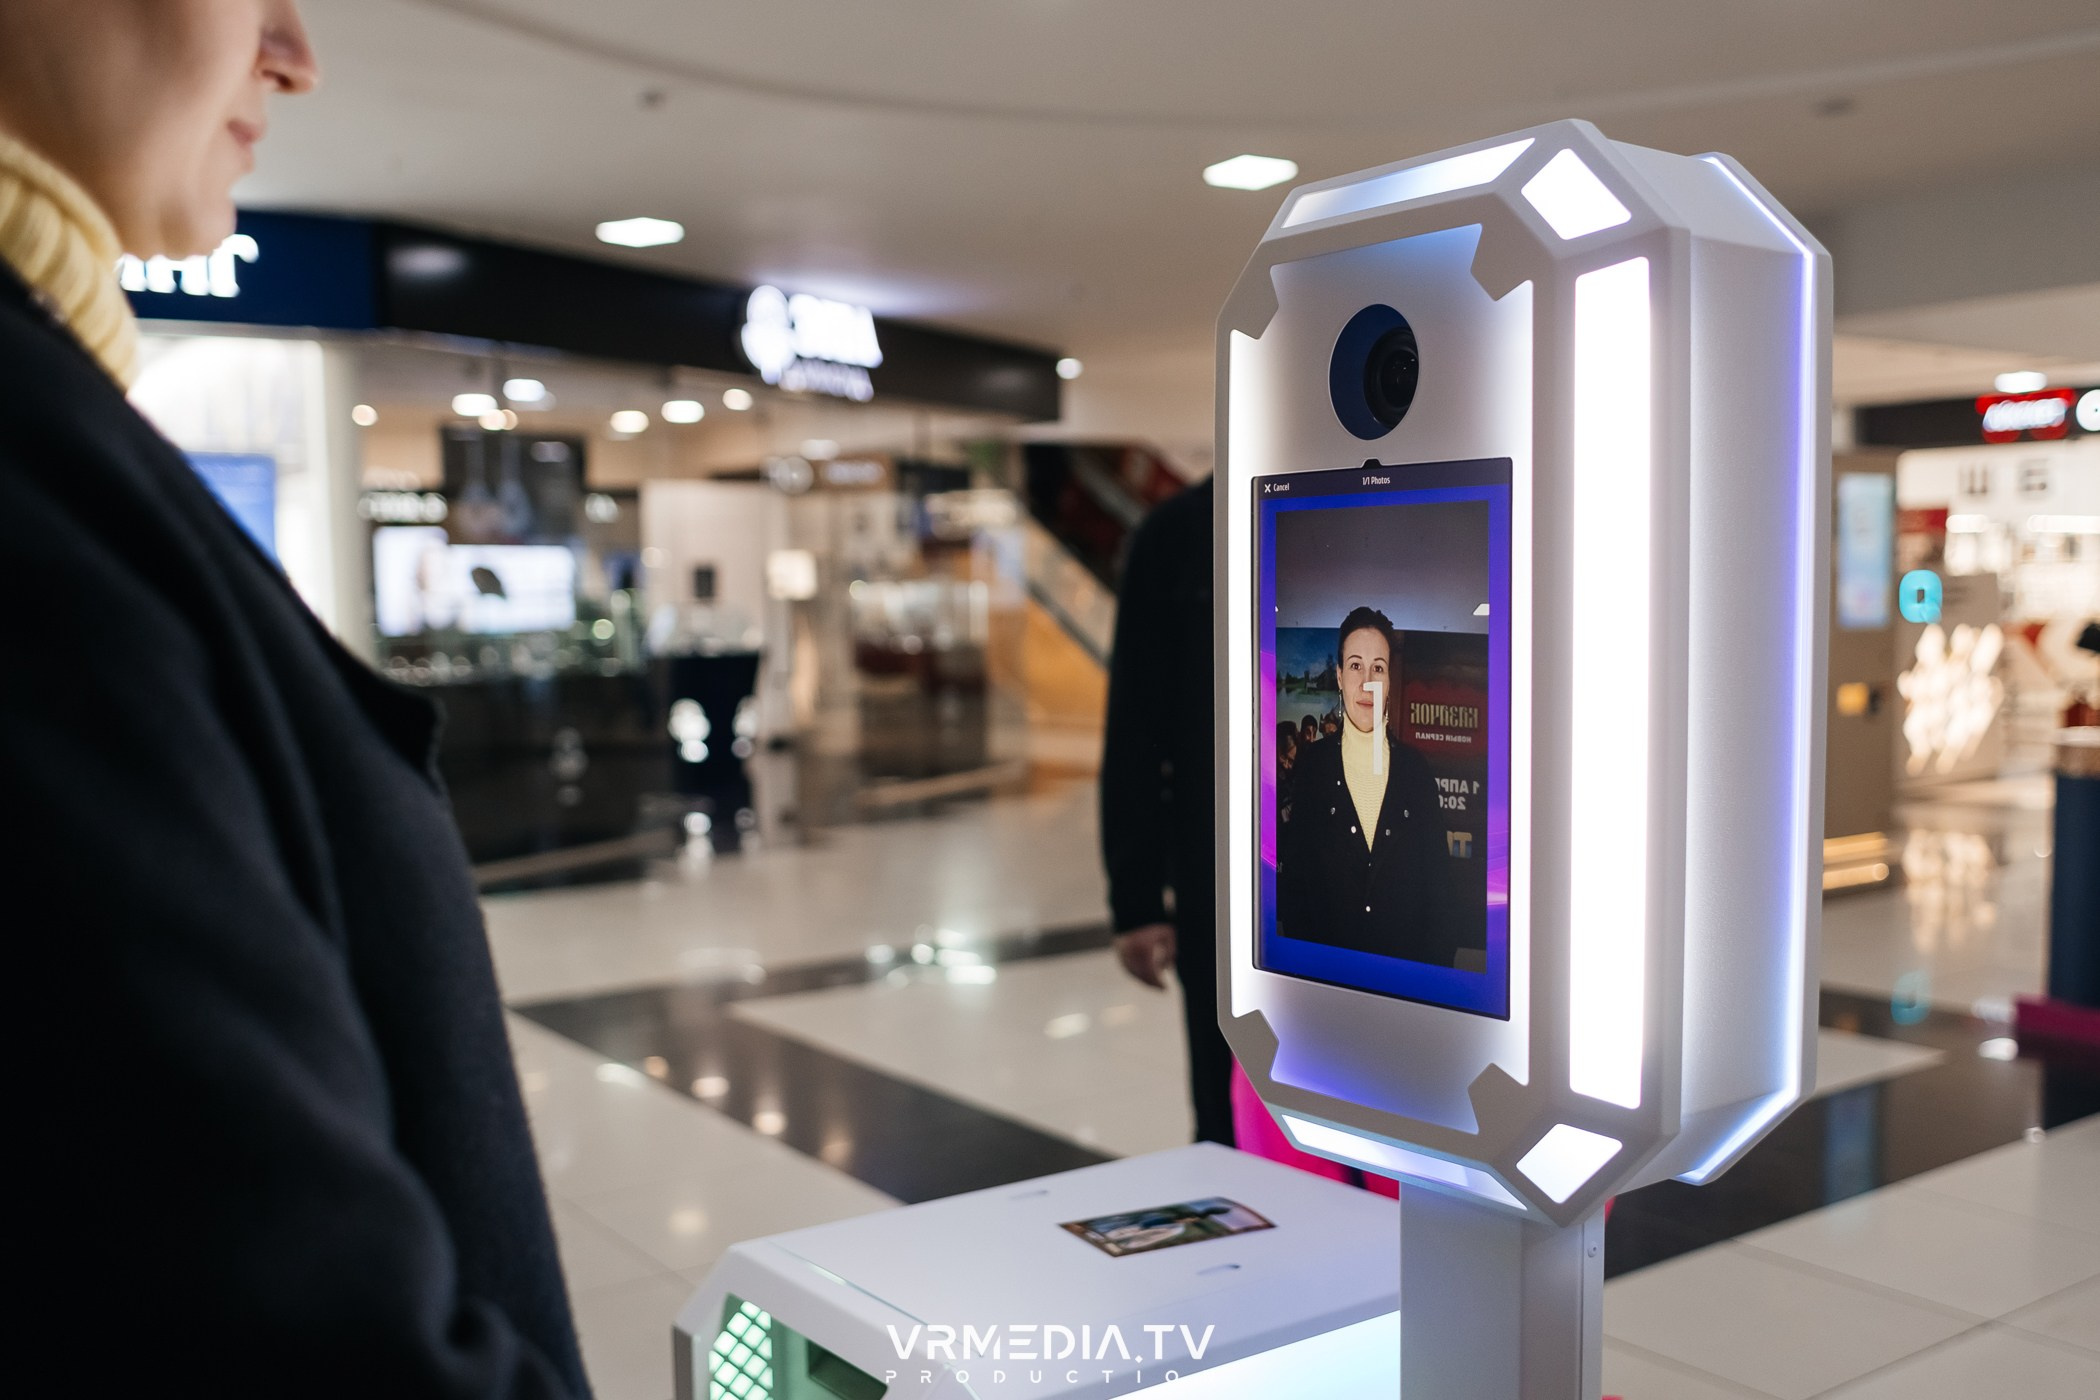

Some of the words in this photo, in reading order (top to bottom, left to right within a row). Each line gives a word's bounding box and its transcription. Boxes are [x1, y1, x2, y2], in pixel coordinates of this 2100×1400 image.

[1362, 476, 1370, 486] 1/1
[1371, 476, 1391, 485] Photos
[1273, 482, 1290, 492] Cancel
[1363, 682, 1383, 775] 1
